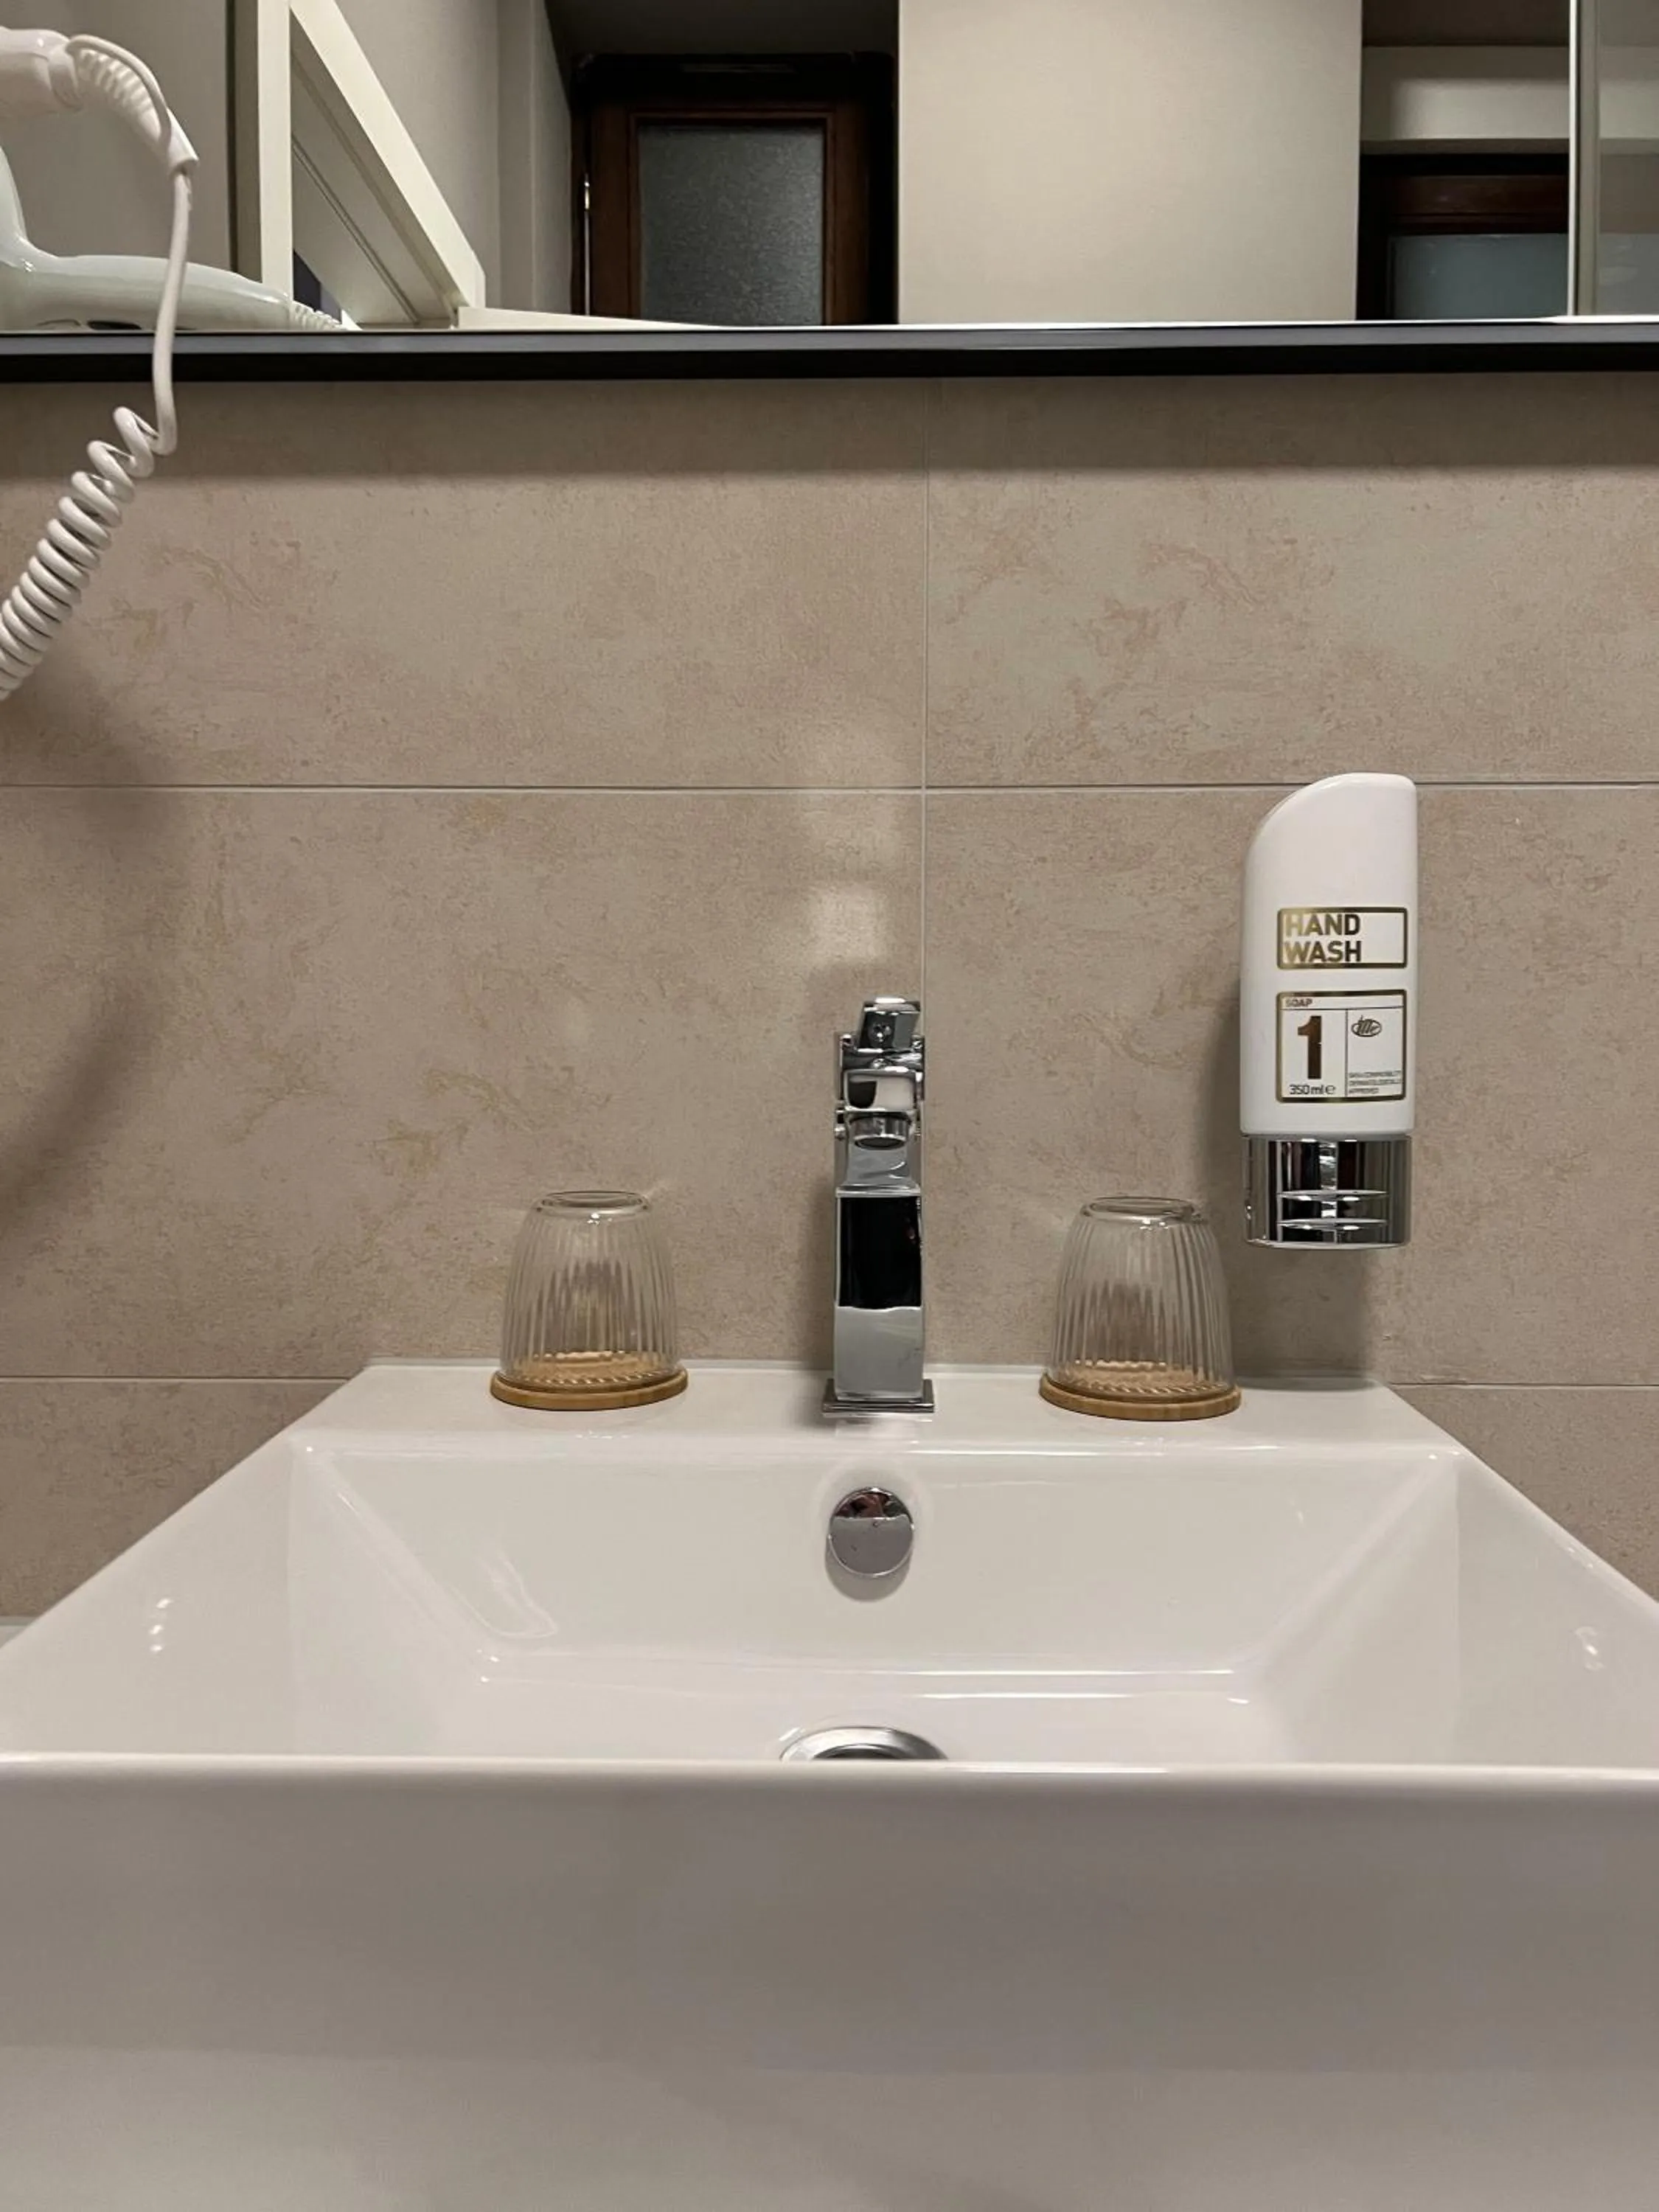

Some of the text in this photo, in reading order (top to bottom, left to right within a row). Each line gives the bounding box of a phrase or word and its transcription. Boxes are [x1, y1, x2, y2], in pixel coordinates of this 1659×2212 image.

[1285, 914, 1360, 936] HAND
[1284, 940, 1361, 962] WASH
[1285, 998, 1312, 1007] SOAP
[1298, 1015, 1321, 1079] 1
